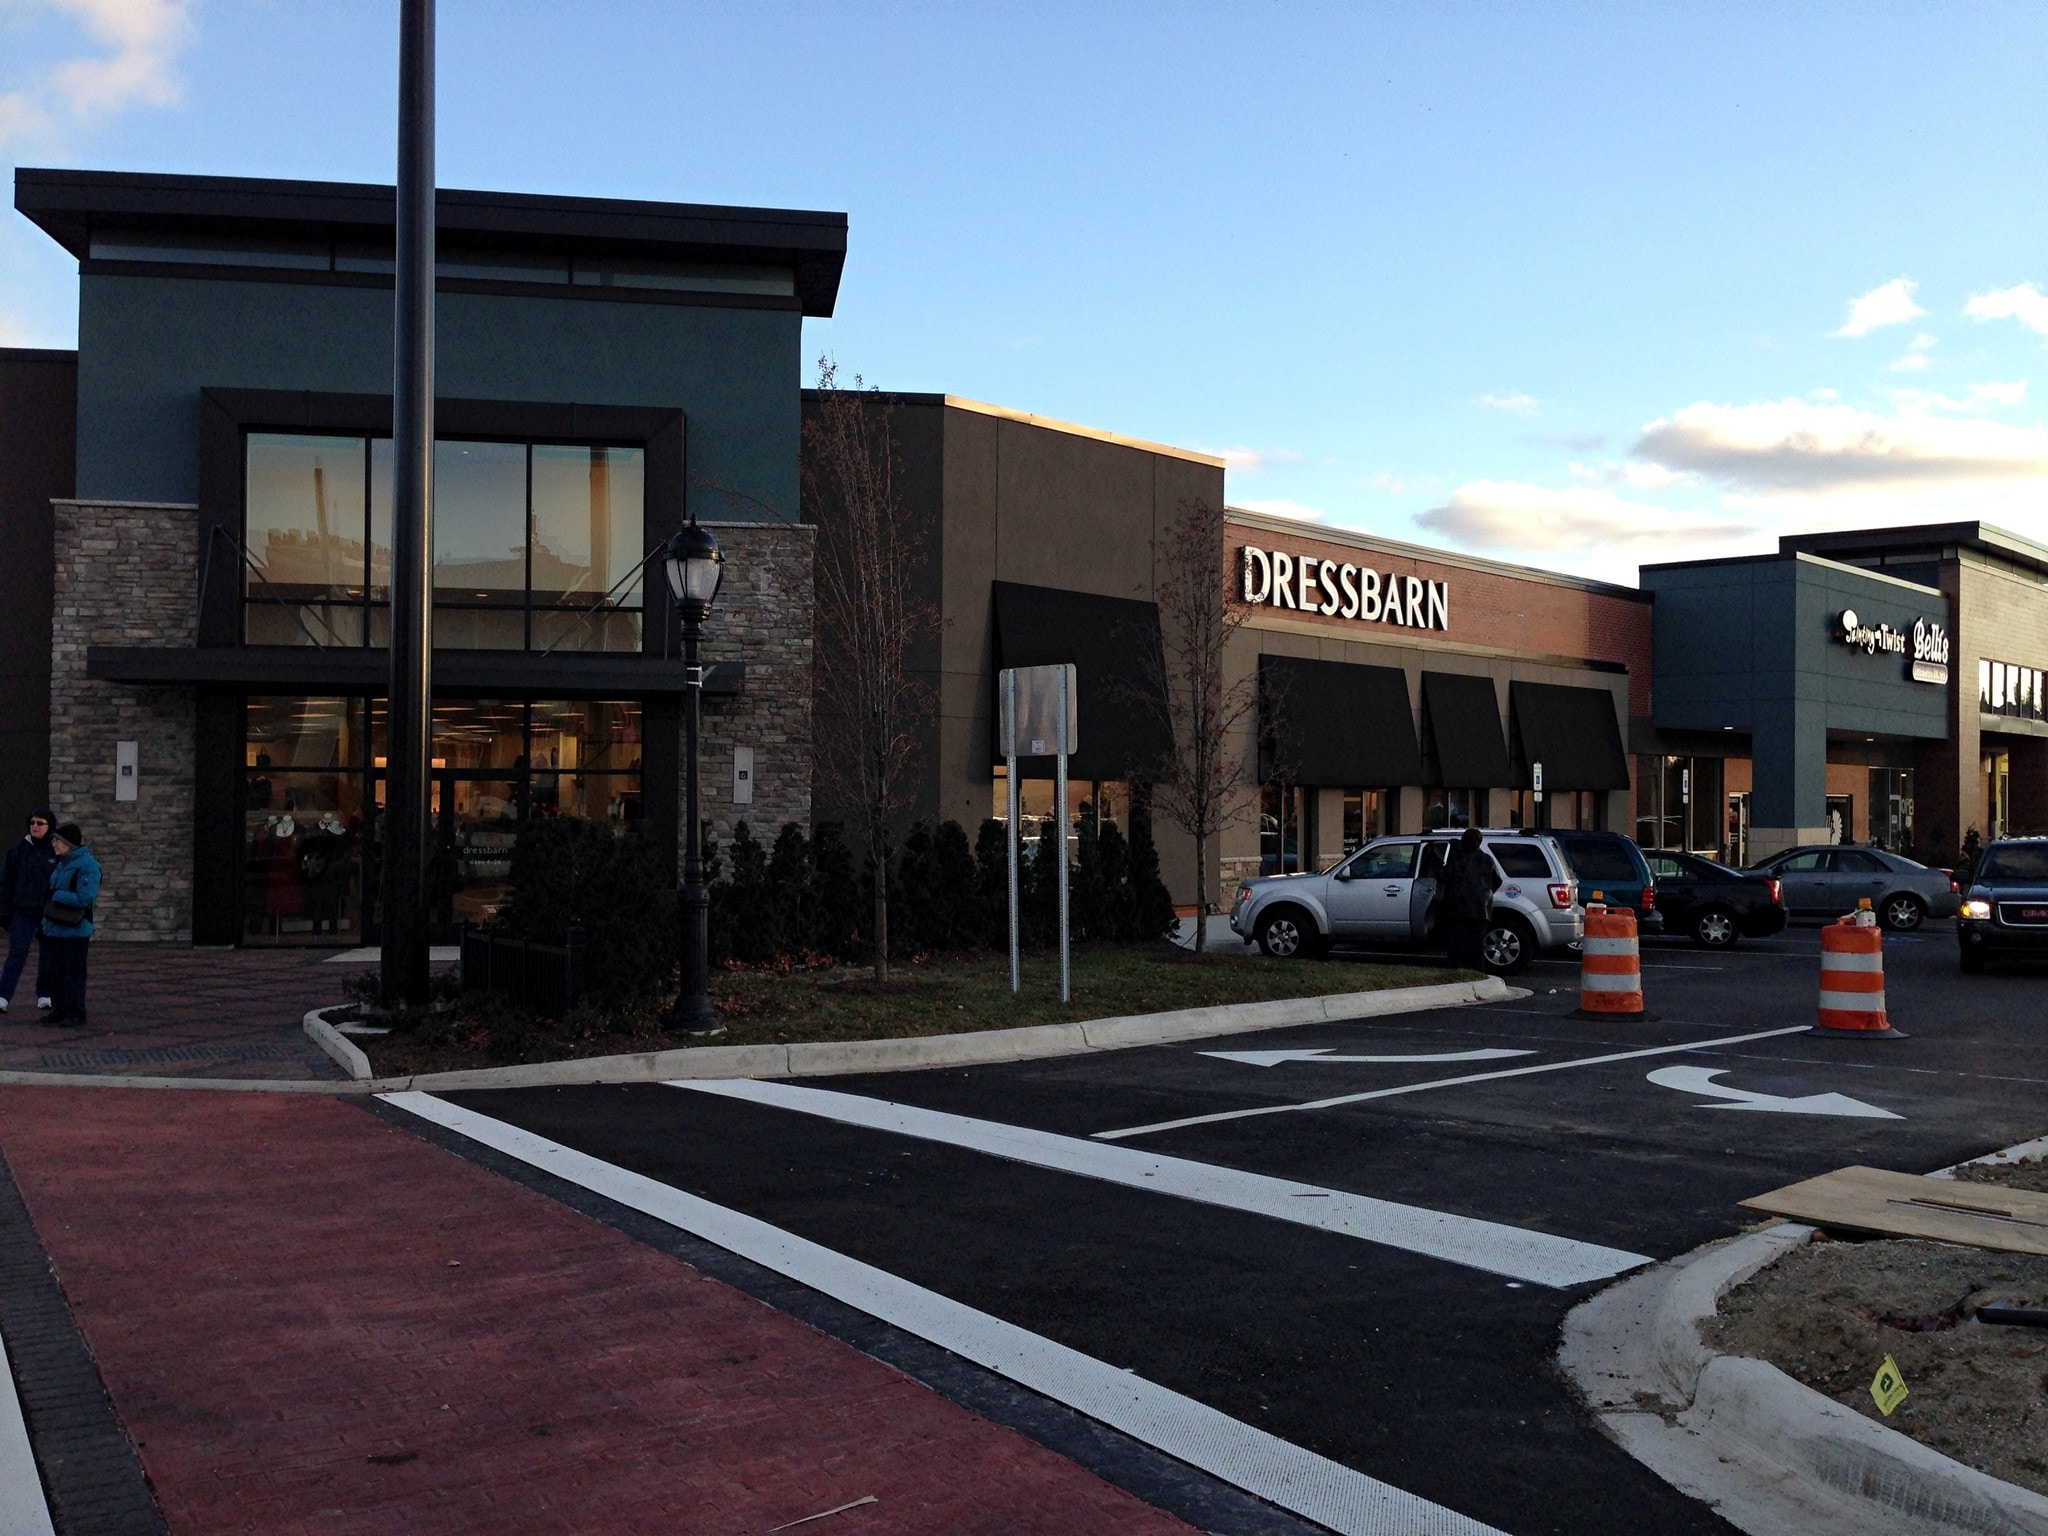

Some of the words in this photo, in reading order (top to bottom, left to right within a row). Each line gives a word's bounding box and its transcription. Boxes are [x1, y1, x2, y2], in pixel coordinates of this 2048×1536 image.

[1243, 545, 1449, 631] DRESSBARN
[1880, 623, 1906, 654] Twist
[462, 845, 508, 855] dressbarn
